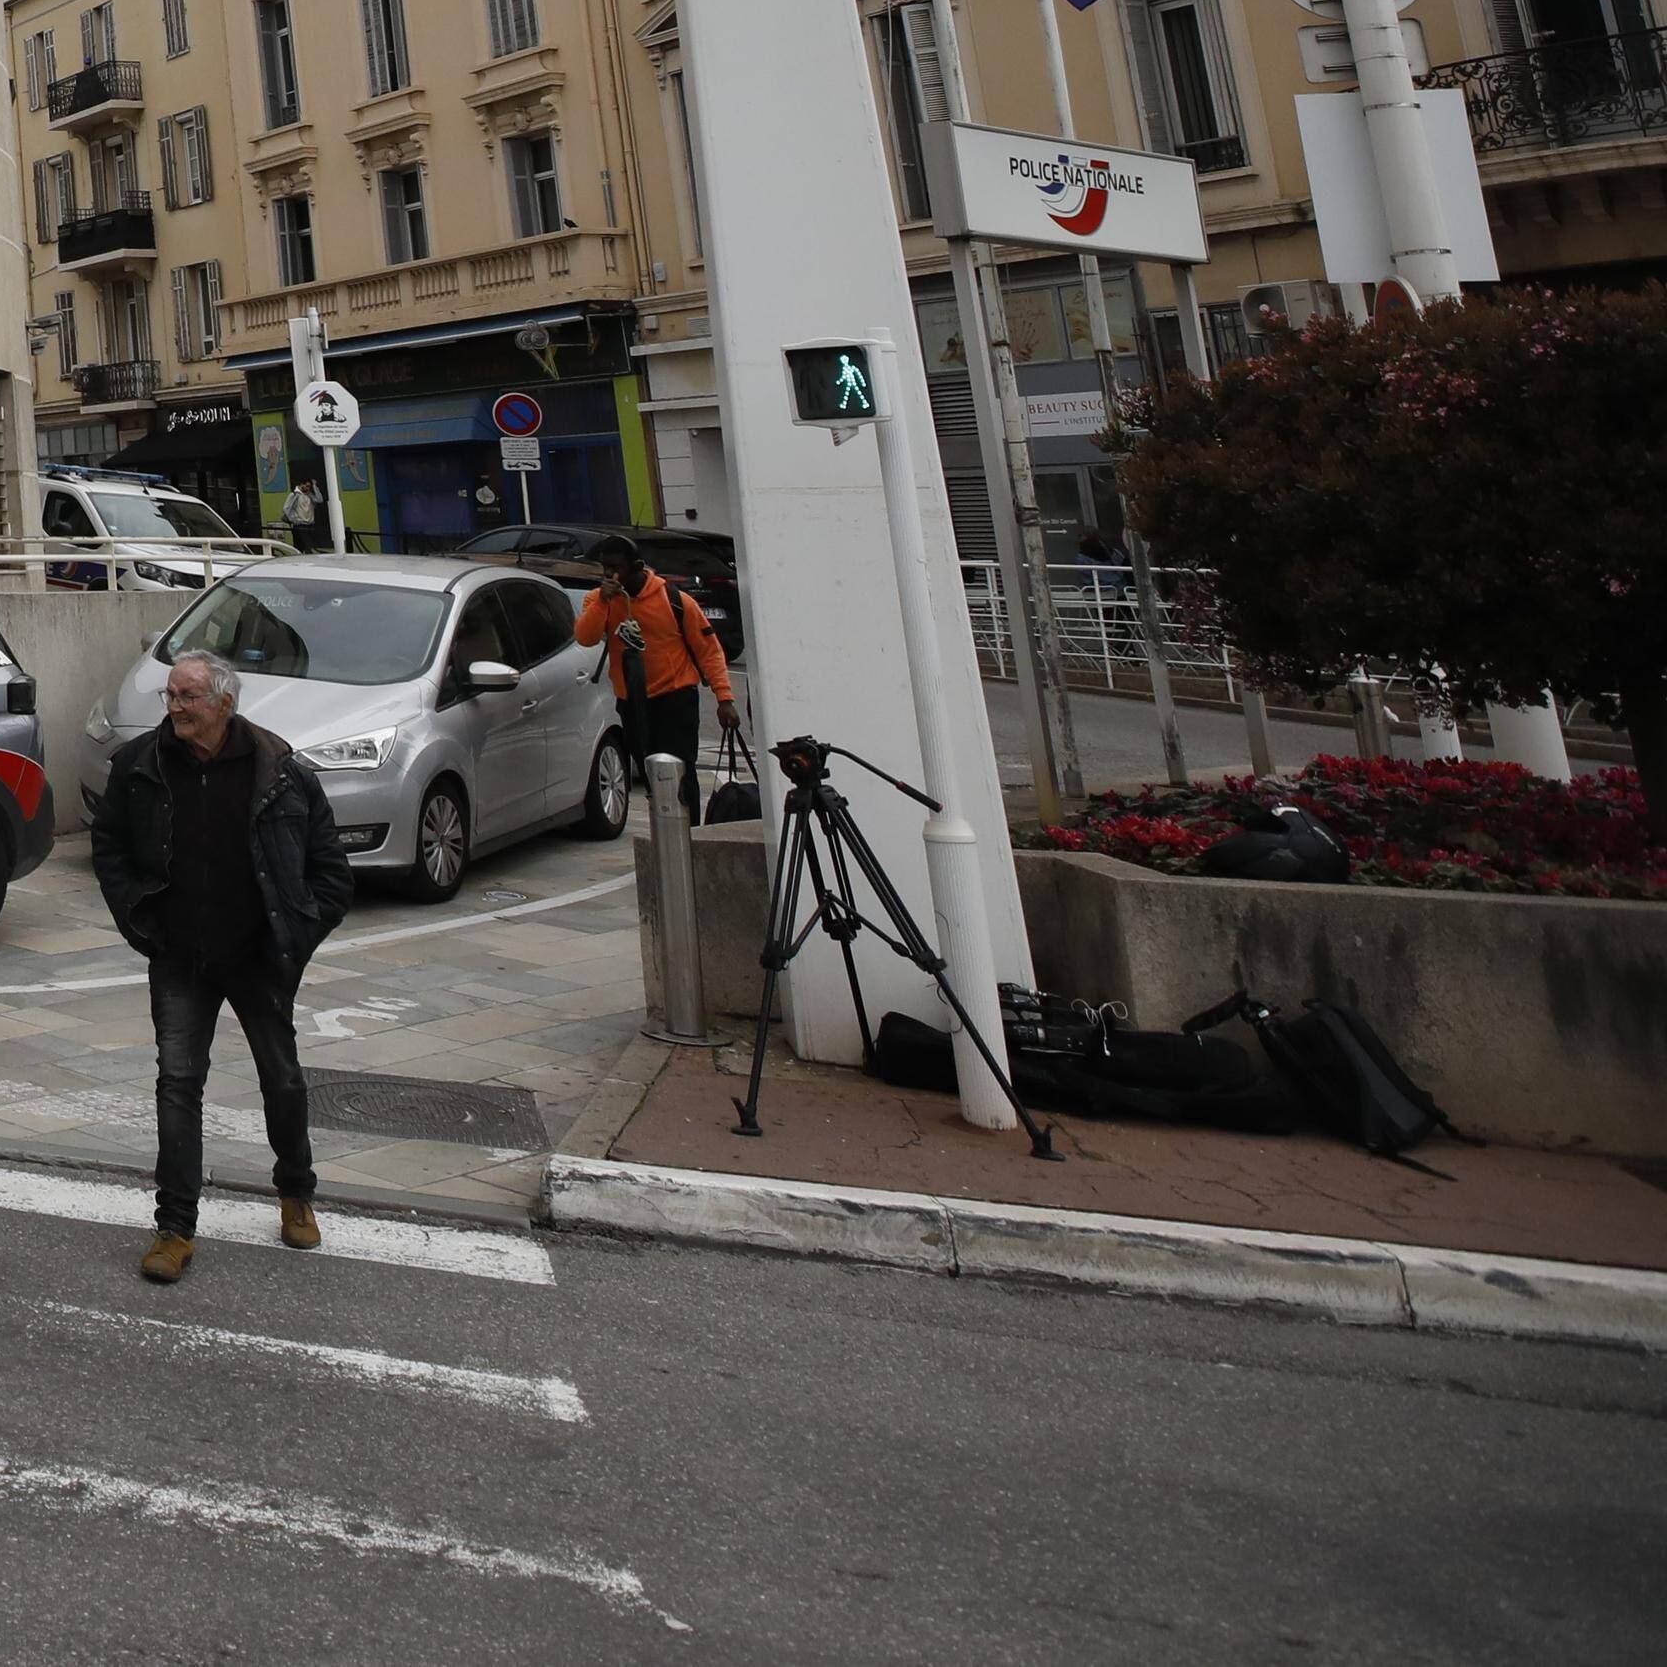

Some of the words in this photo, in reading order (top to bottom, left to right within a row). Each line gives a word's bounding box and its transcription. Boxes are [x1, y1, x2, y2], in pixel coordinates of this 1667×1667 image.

[1009, 156, 1061, 183] POLICE
[1063, 164, 1145, 195] NATIONALE
[1027, 400, 1078, 415] BEAUTY
[256, 595, 294, 607] POLICE
